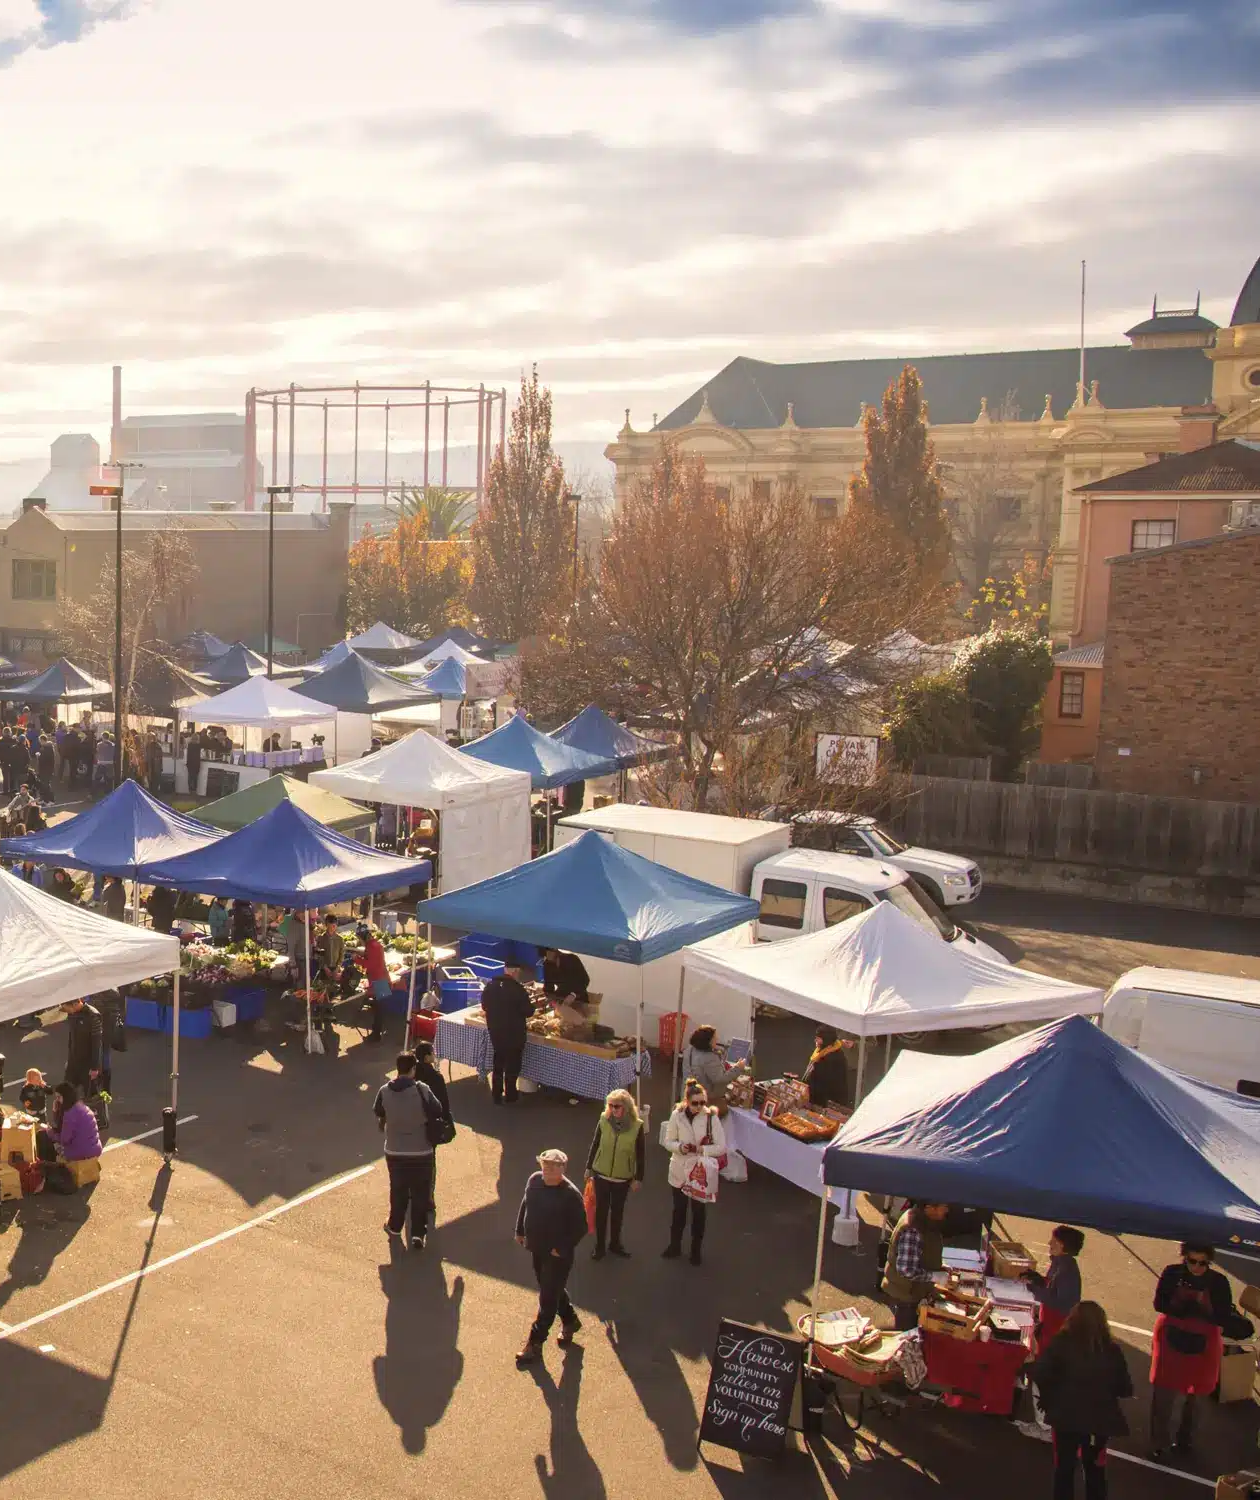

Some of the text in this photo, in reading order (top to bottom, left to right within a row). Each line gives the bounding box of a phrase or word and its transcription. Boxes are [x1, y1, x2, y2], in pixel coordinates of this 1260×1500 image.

[717, 1336, 794, 1373] Harvest
[760, 1343, 774, 1353] THE
[714, 1372, 782, 1399] relies on
[724, 1361, 780, 1384] COMMUNITY
[714, 1383, 780, 1409] VOLUNTEERS
[707, 1398, 786, 1442] Sign up here
